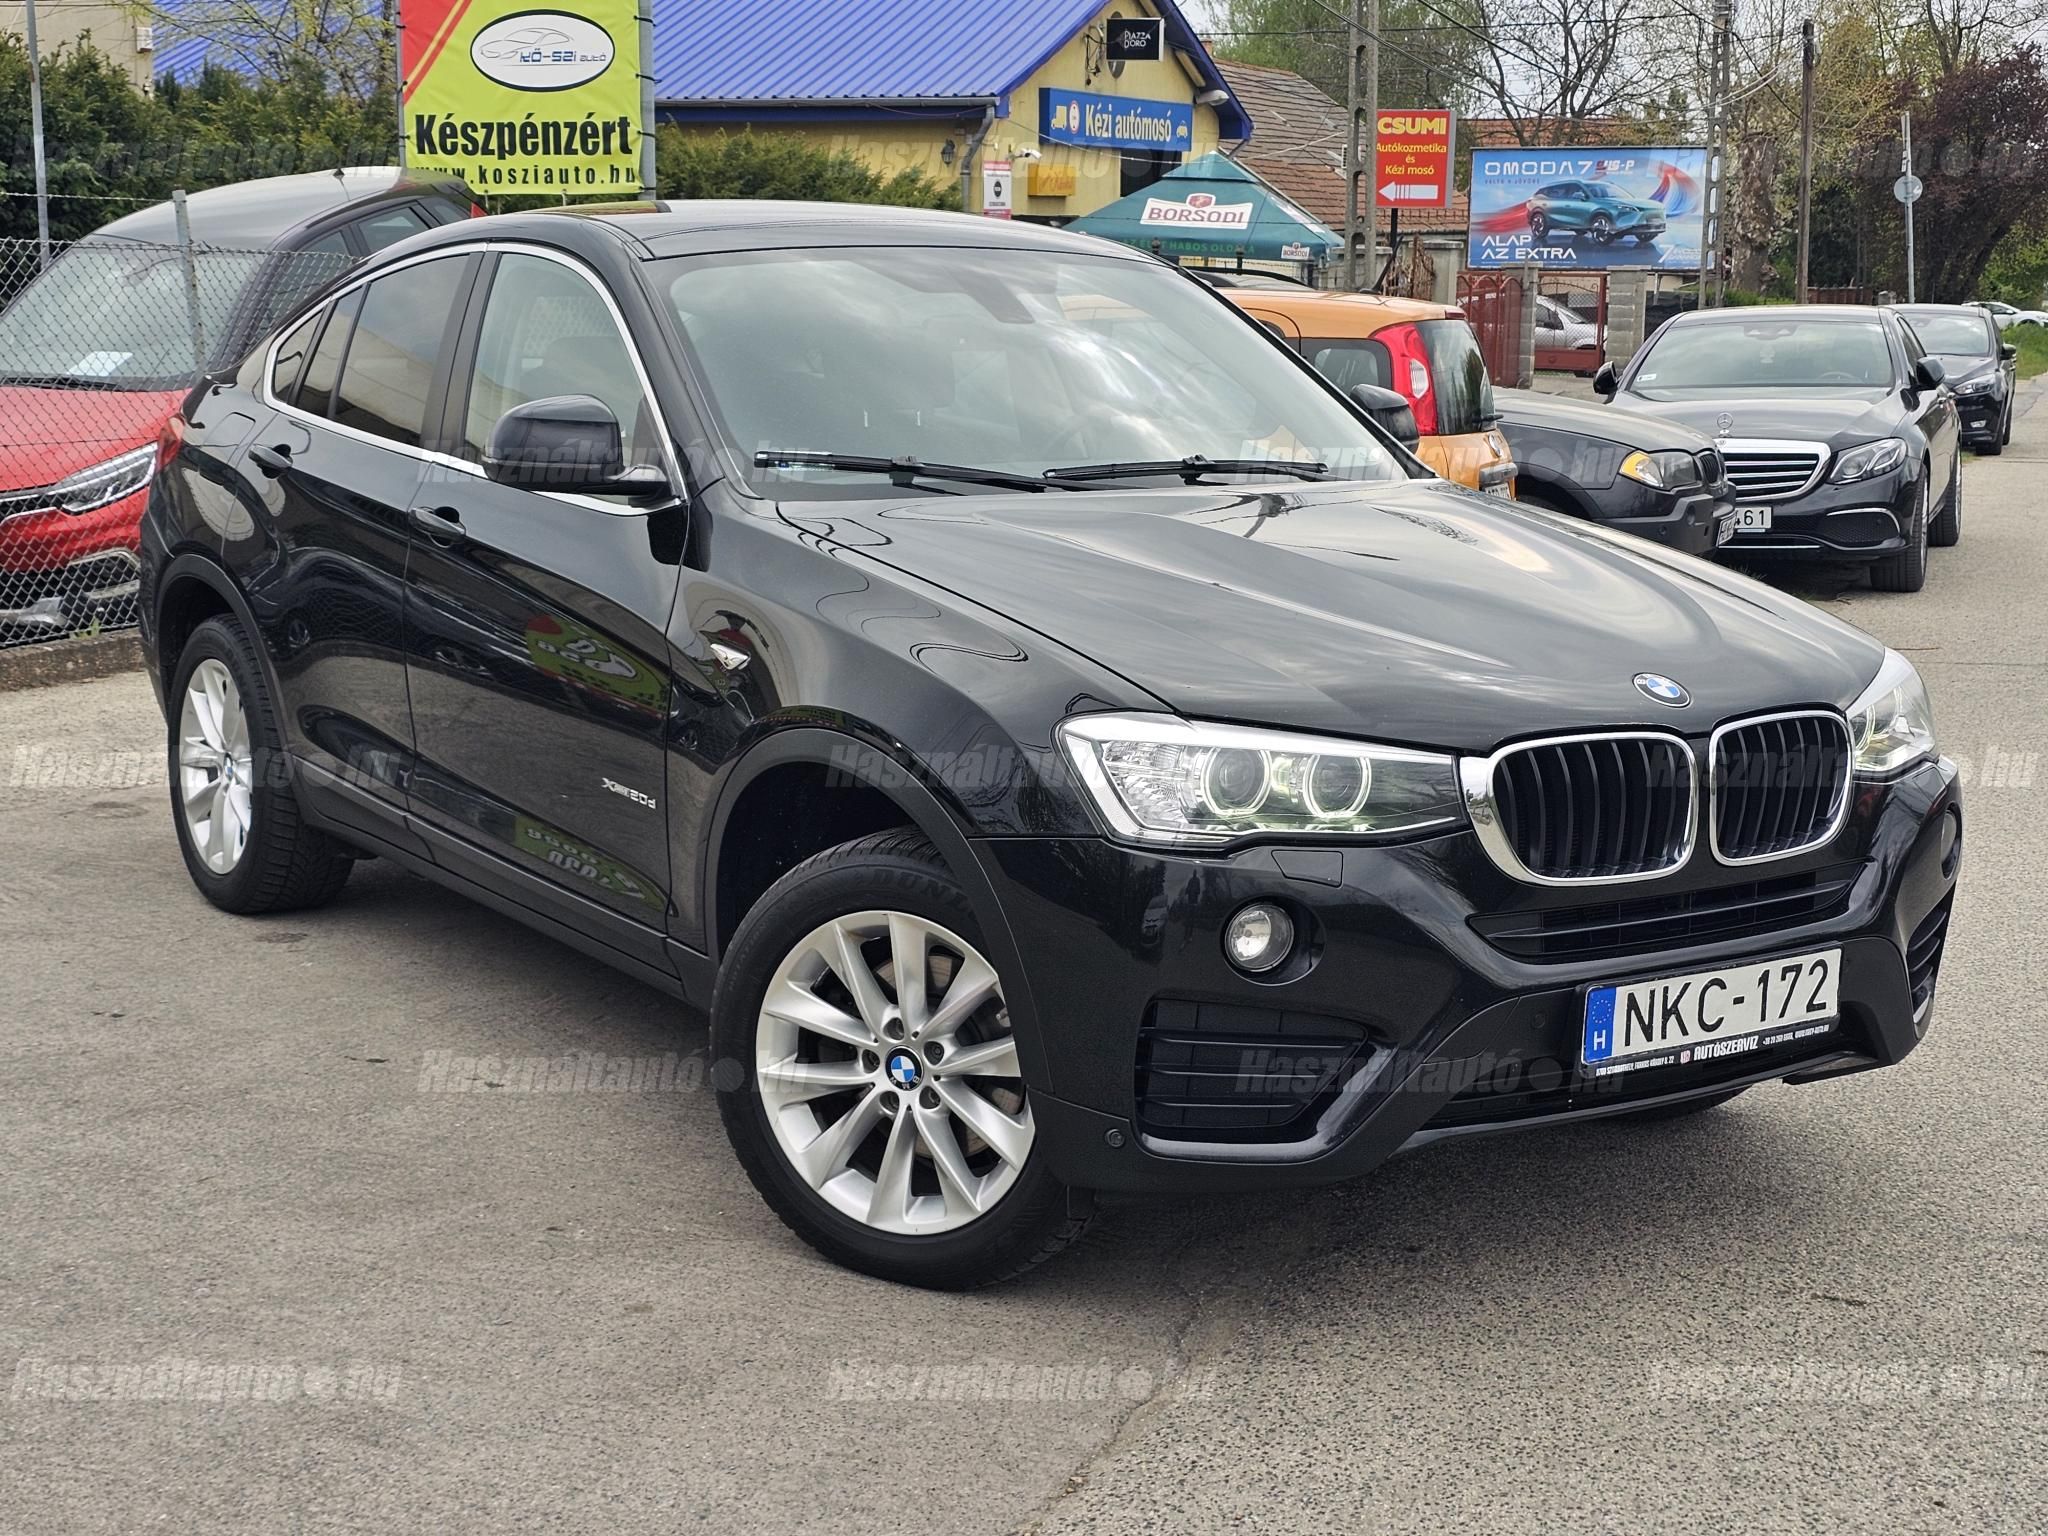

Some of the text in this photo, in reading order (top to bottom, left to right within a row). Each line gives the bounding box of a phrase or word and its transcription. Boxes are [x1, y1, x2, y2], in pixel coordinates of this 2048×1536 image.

[1124, 30, 1152, 40] PIAZZA
[1085, 99, 1172, 143] Kézi autómosó
[1377, 117, 1447, 135] CSUMI
[415, 112, 633, 160] Készpénzért
[1376, 142, 1447, 153] Autókozmetika
[1405, 154, 1416, 164] és
[416, 164, 635, 185] w.kosziauto.hu
[1385, 163, 1435, 175] Kézi mosó
[1484, 160, 1575, 176] OMODA
[1577, 160, 1593, 174] 7
[1149, 206, 1245, 224] BORSODI
[1169, 240, 1208, 252] HABOS
[1210, 243, 1255, 254] OLDA
[1482, 235, 1532, 247] ALAP
[1481, 247, 1577, 260] AZ EXTRA
[1624, 957, 1831, 1047] NKC-172
[1593, 1029, 1606, 1051] H
[1693, 1035, 1759, 1061] AUTÓSZERVIZ
